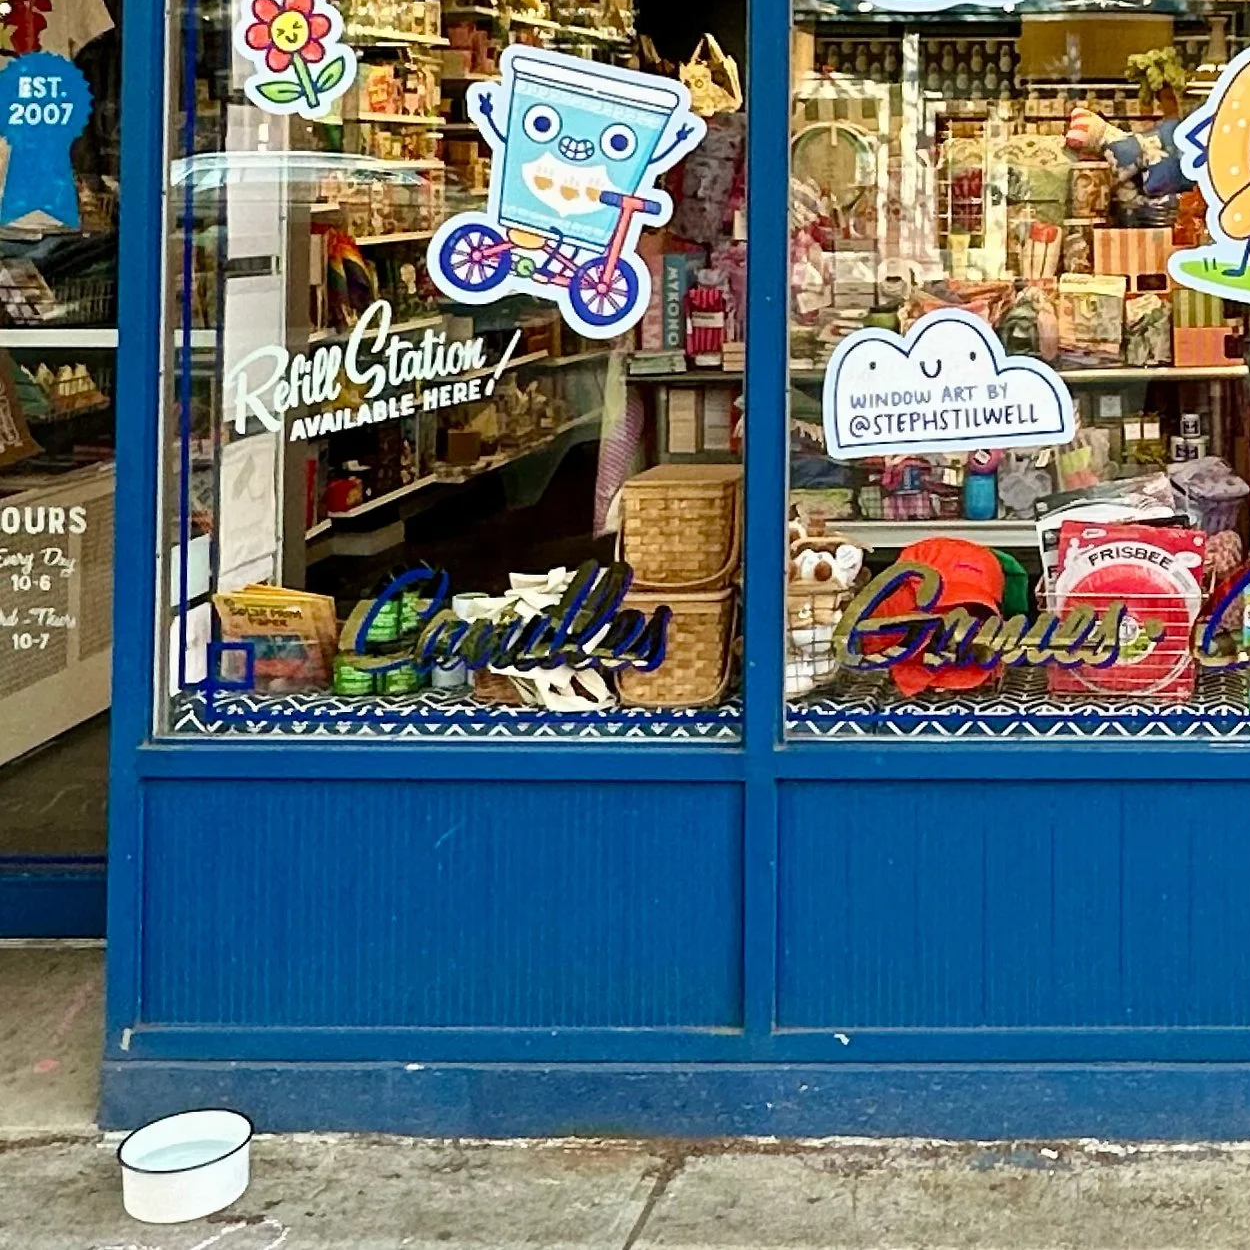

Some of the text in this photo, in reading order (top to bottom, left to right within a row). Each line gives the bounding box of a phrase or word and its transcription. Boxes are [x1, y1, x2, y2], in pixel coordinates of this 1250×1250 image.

[18, 76, 68, 99] EST.
[8, 102, 74, 126] 2007
[223, 299, 487, 434] Refill Station
[850, 382, 1009, 409] WINDOW ART BY
[289, 393, 416, 442] AVAILABLE
[850, 404, 1039, 438] @STEPHSTILWELL
[1088, 546, 1175, 571] FRISBEE
[11, 574, 51, 591] 10-6
[338, 559, 673, 674] Candles
[832, 559, 1128, 671] Games
[12, 633, 50, 650] 10-7
